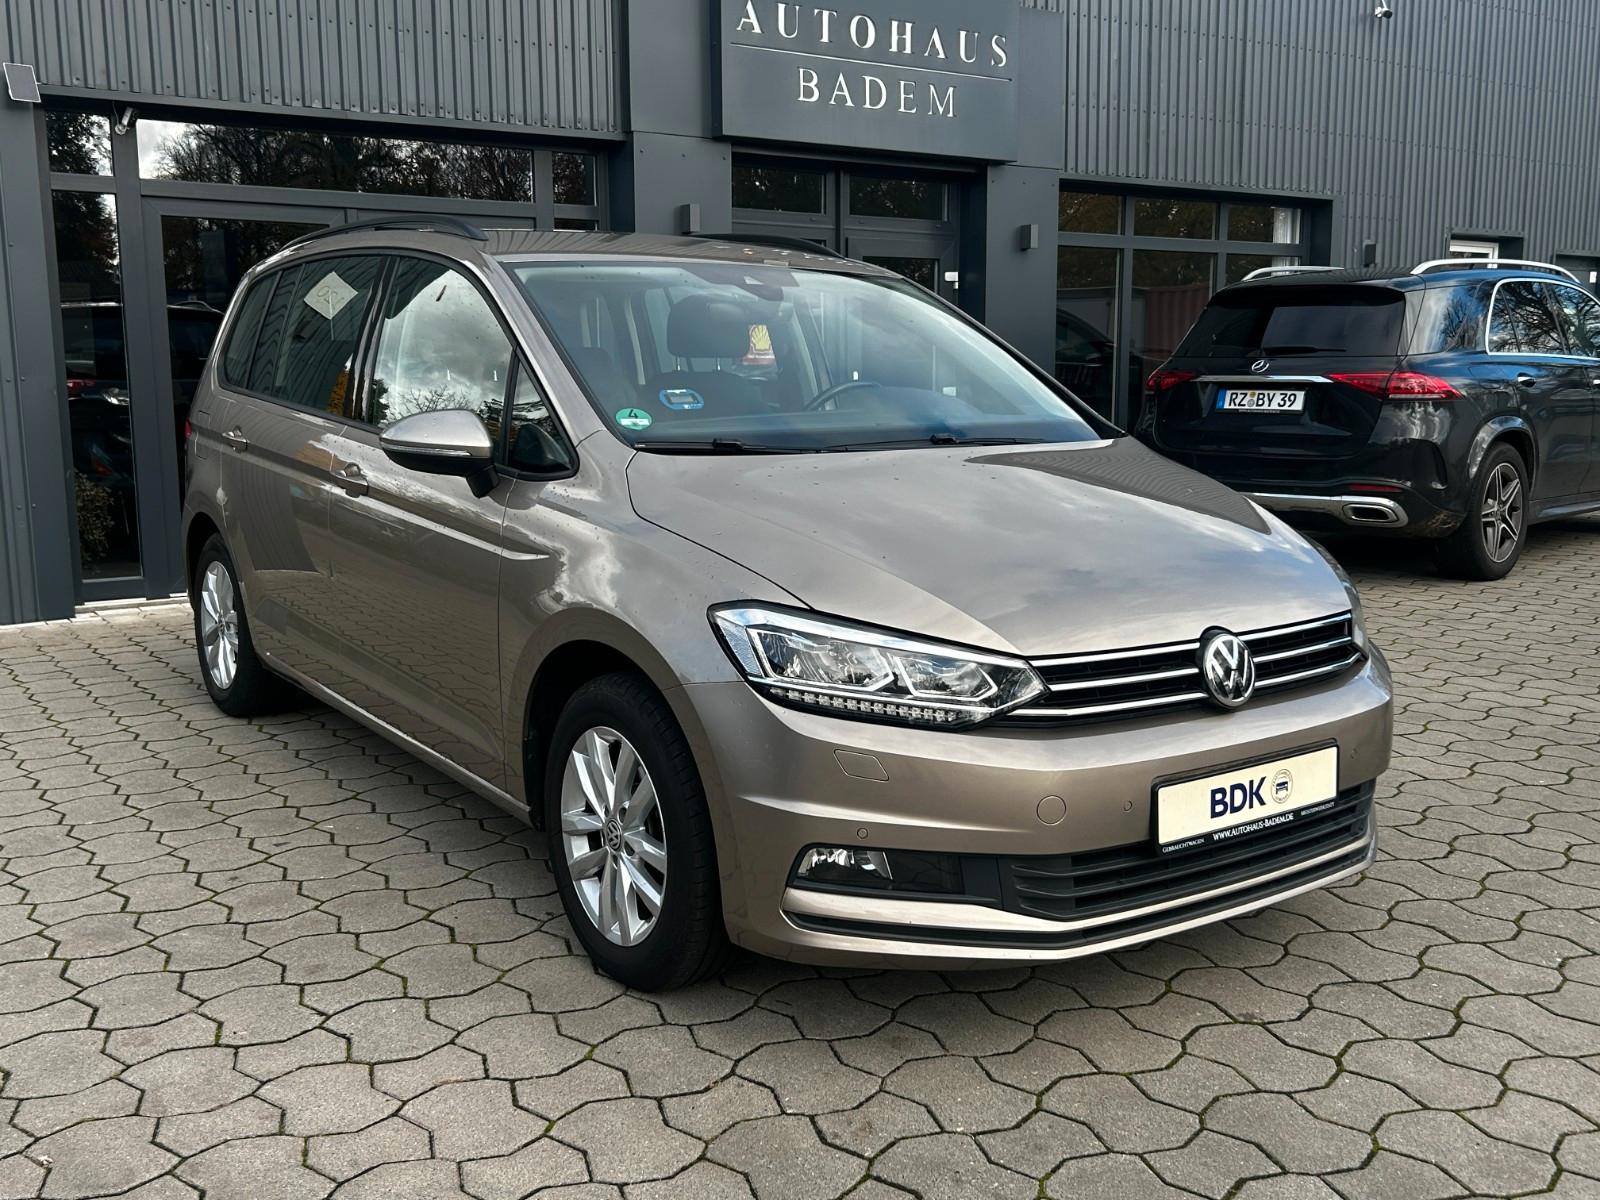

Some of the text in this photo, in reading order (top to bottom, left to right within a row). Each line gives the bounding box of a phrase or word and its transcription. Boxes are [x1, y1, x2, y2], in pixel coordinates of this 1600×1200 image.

[736, 0, 1008, 67] AUTOHAUS
[797, 67, 957, 117] BADEM
[628, 408, 638, 419] 4
[1228, 392, 1297, 408] RZ BY 39
[1210, 776, 1267, 819] BDK
